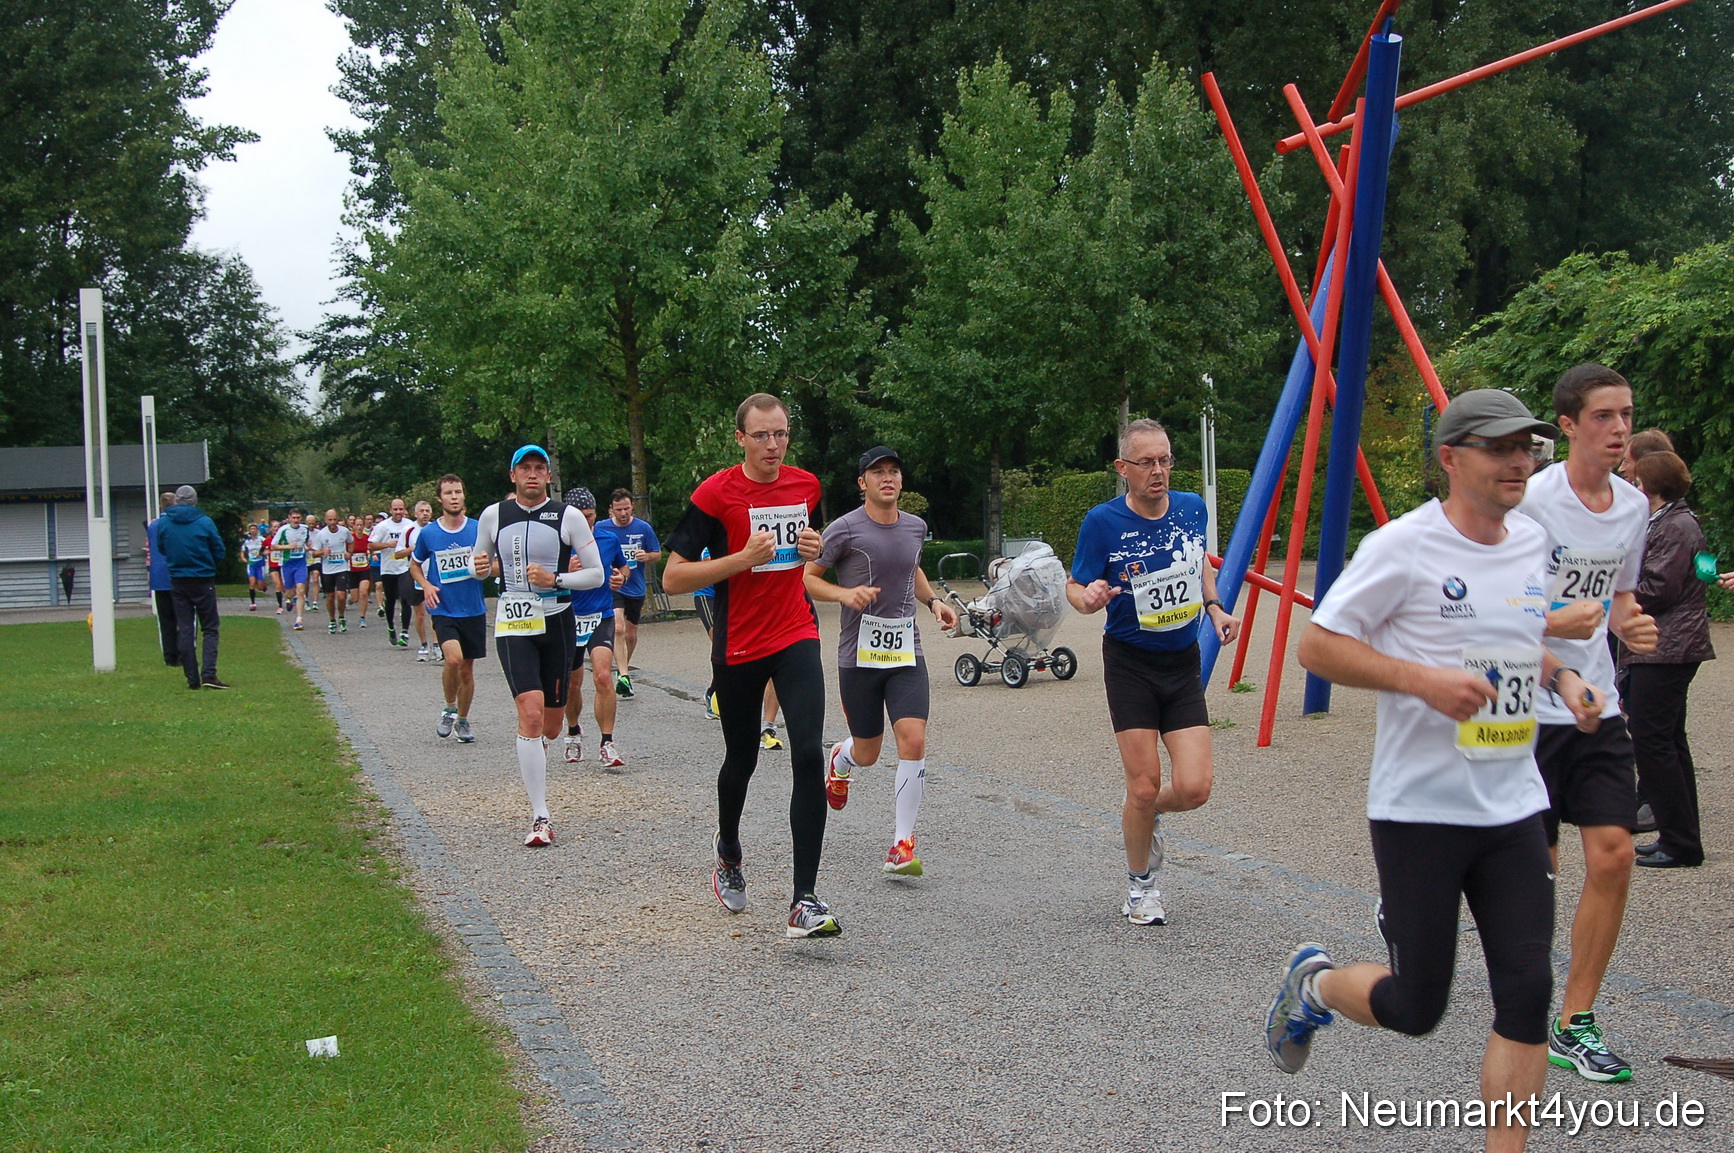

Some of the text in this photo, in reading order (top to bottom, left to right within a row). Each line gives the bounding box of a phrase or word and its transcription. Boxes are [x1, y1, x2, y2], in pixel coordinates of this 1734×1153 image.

[751, 513, 773, 521] PARTL
[513, 536, 521, 555] Roth
[515, 569, 523, 584] TSG
[1561, 568, 1616, 599] 2461
[1133, 581, 1156, 590] PARTL
[1148, 580, 1190, 610] 342
[504, 602, 534, 619] 502
[1157, 611, 1188, 625] Markus
[862, 619, 881, 628] PARTL
[870, 629, 903, 650] 395
